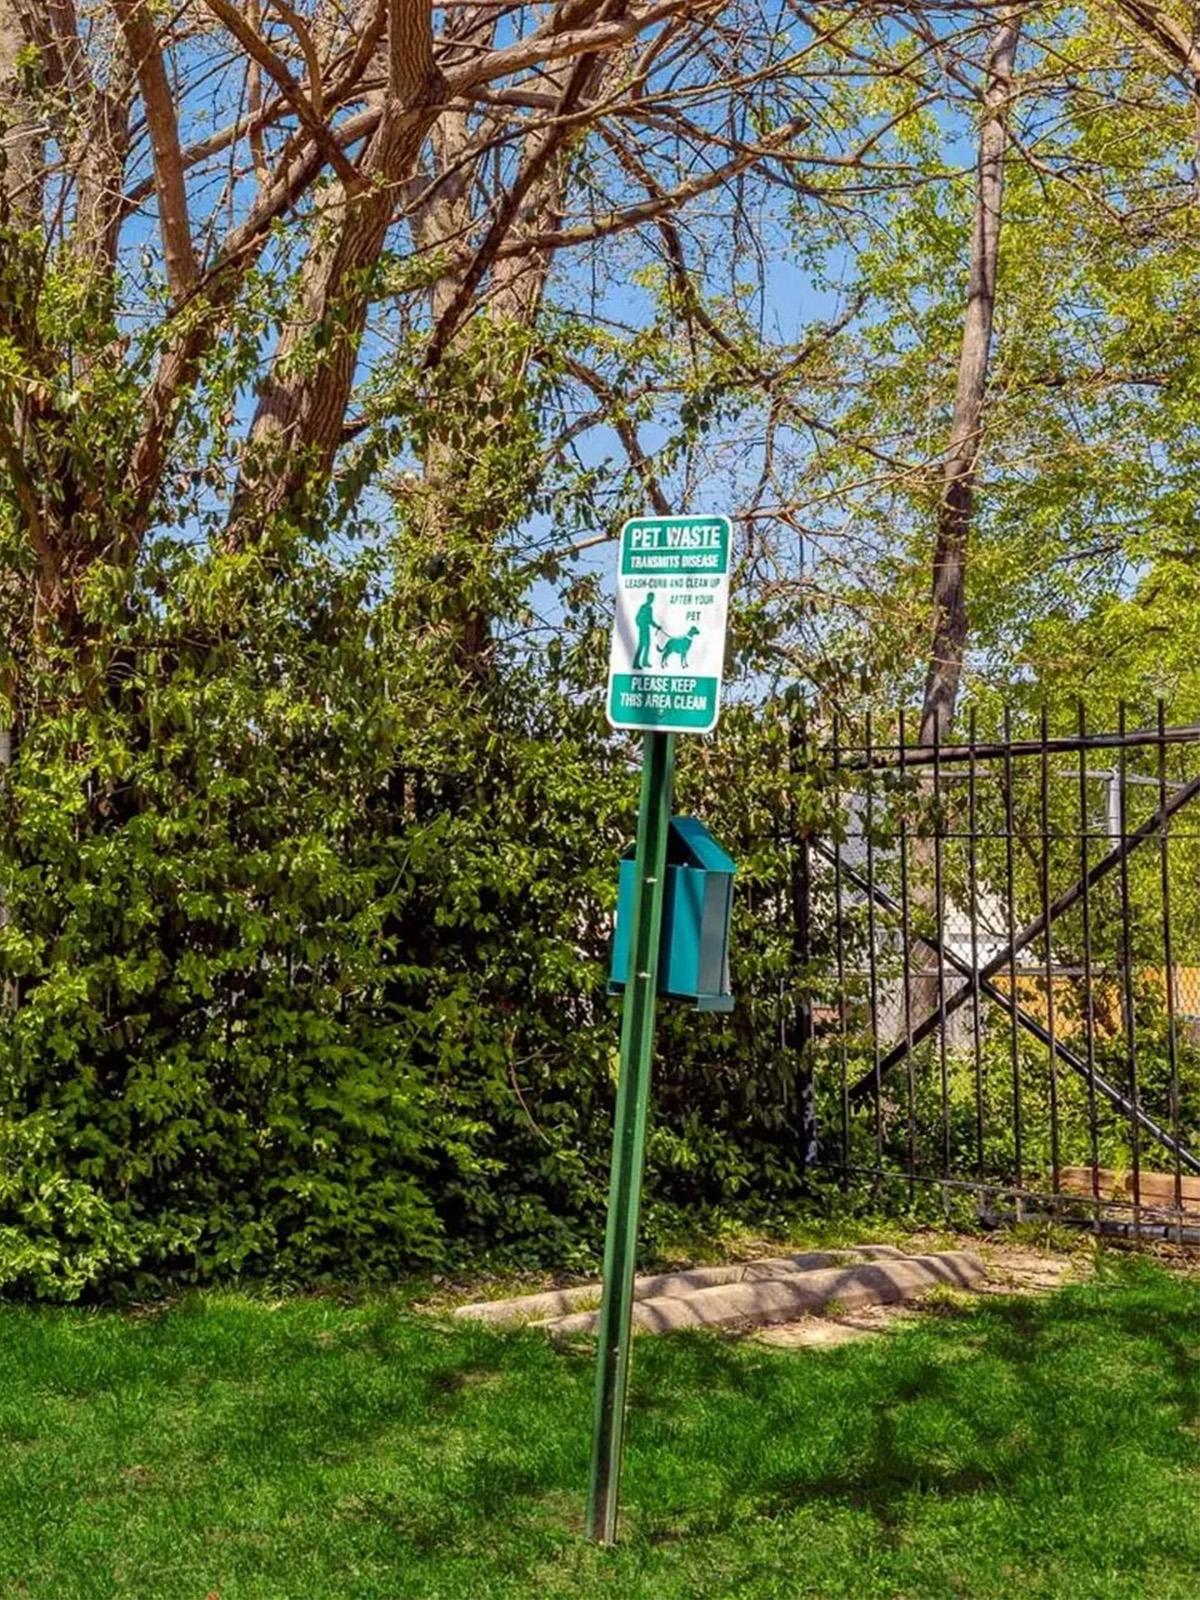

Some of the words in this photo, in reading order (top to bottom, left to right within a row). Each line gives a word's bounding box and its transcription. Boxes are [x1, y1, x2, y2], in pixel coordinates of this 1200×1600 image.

[631, 528, 661, 548] PET
[666, 525, 721, 547] WASTE
[631, 555, 680, 568] TRANSMITS
[681, 554, 718, 568] DISEASE
[670, 578, 684, 588] AND
[686, 578, 708, 588] CLEAN
[710, 578, 721, 588] UP
[670, 594, 692, 605] AFTER
[695, 594, 714, 605] YOUR
[686, 611, 701, 621] PET
[631, 676, 669, 692] PLEASE
[671, 678, 697, 693] KEEP
[619, 692, 642, 708] THIS
[644, 693, 672, 709] AREA
[674, 695, 707, 711] CLEAN
